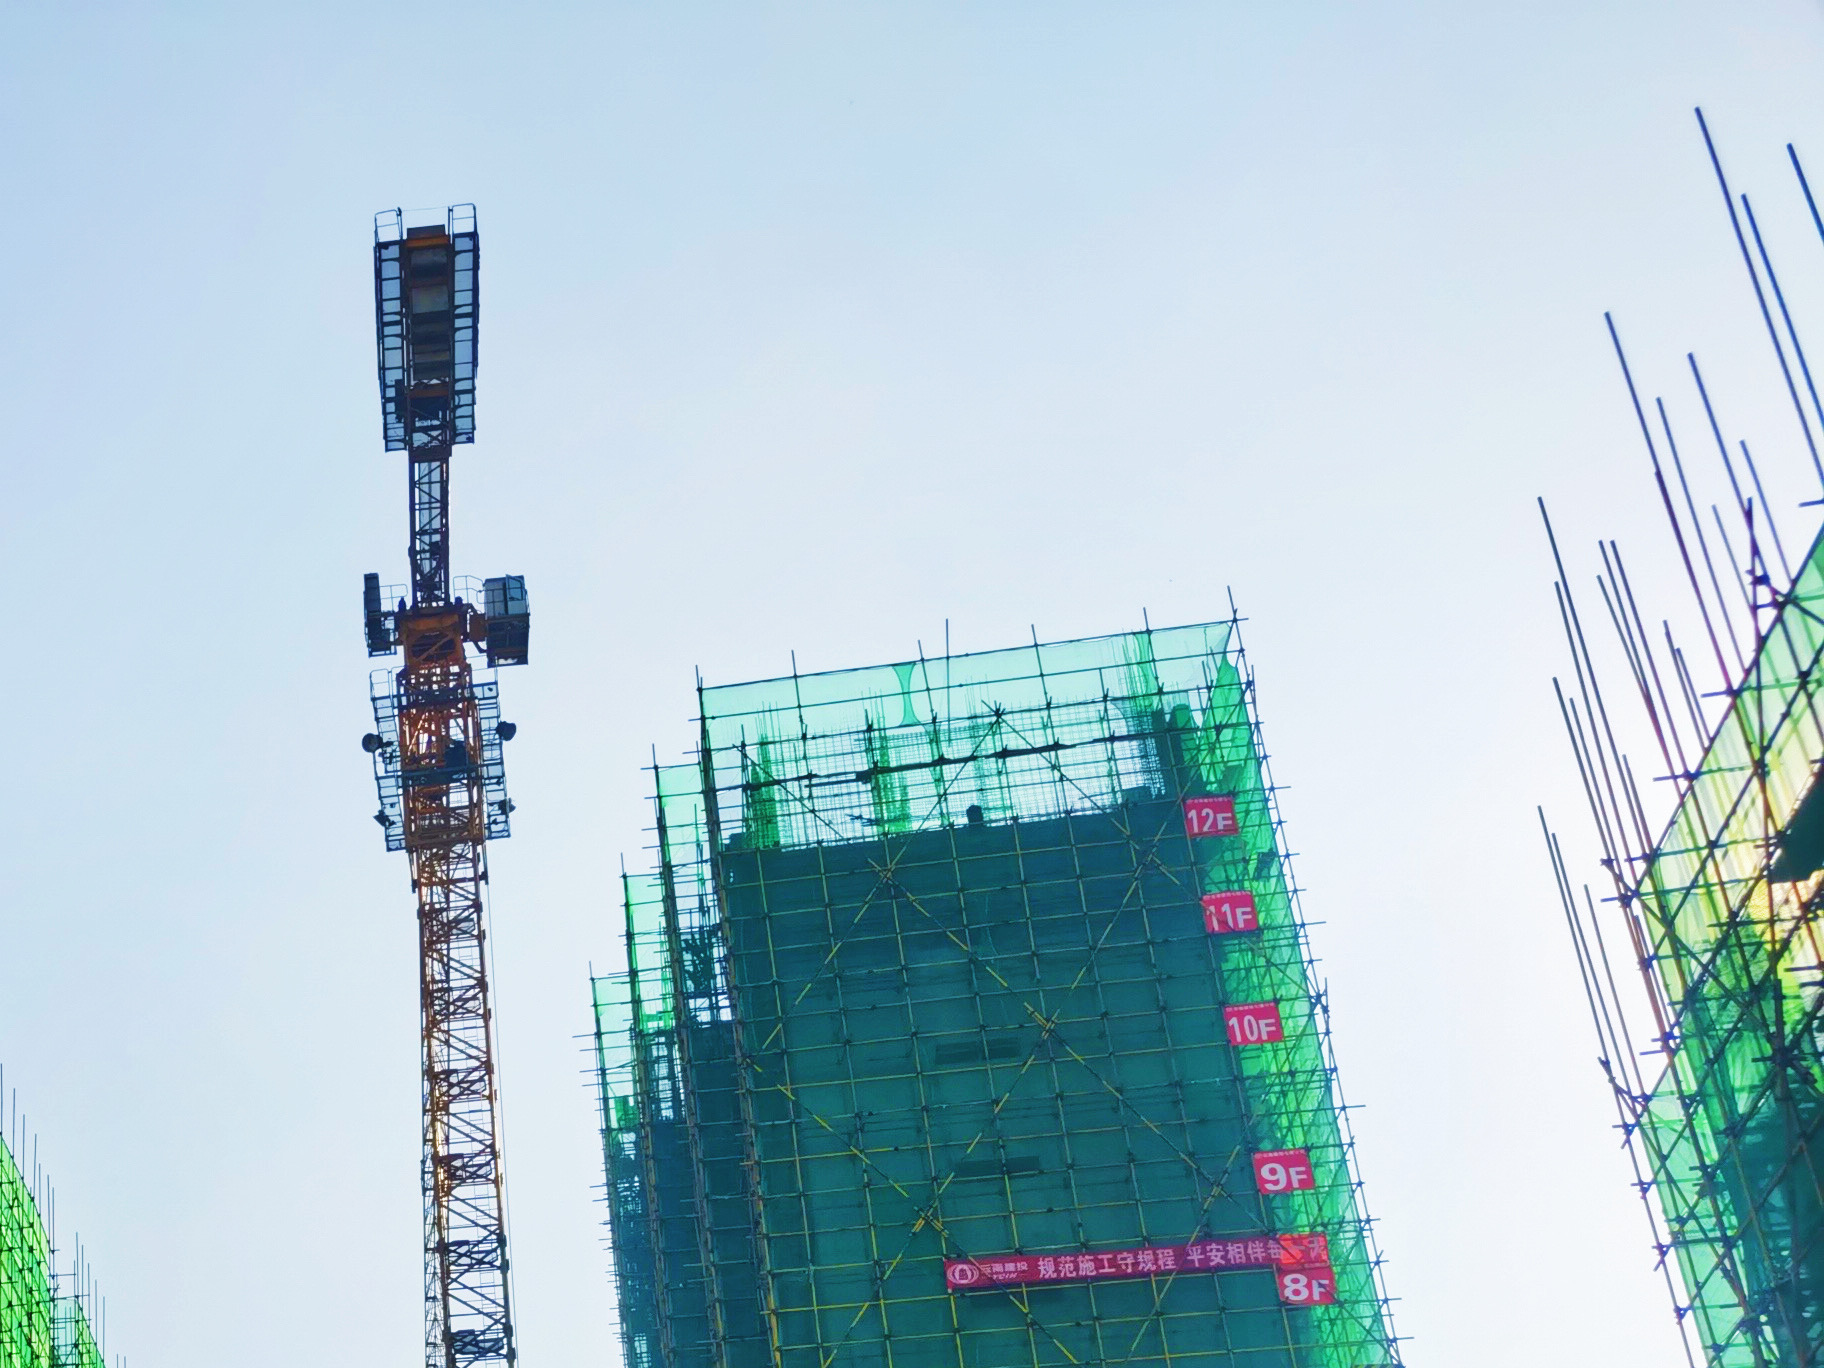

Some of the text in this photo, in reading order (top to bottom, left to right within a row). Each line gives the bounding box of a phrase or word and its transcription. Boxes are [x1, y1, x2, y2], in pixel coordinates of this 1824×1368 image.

[1188, 808, 1233, 833] 12F
[1206, 903, 1253, 931] 11F
[1229, 1015, 1277, 1042] 10F
[1261, 1163, 1307, 1190] 9F
[1283, 1273, 1330, 1301] 8F
